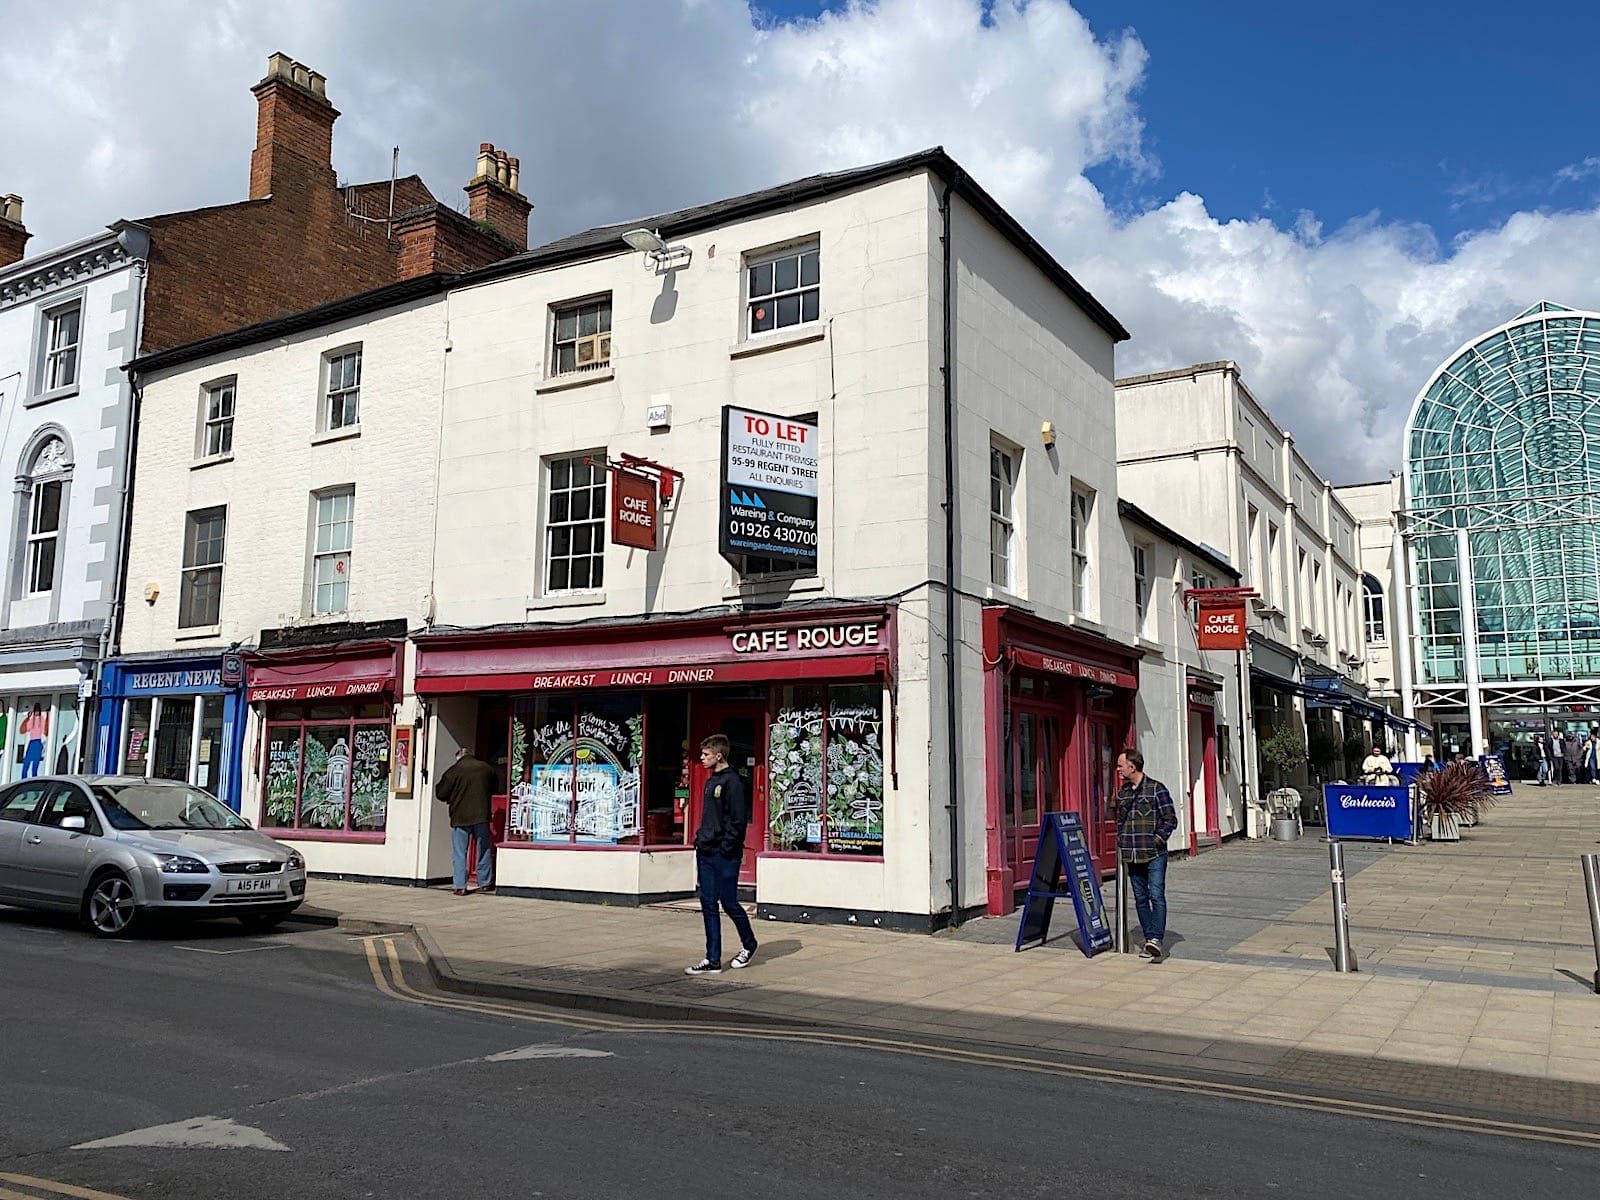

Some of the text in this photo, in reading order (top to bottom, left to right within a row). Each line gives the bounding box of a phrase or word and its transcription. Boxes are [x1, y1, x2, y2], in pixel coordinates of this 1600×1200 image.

[744, 415, 808, 443] TO LET
[752, 438, 801, 454] FULLY FITTED
[732, 444, 817, 467] RESTAURANT PREMISES
[732, 456, 818, 479] 95-99 REGENT STREET
[749, 472, 803, 488] ALL ENQUIRIES
[619, 509, 652, 527] ROUGE
[731, 505, 816, 529] Wareing & Company
[730, 520, 817, 545] 01926 430700
[730, 538, 816, 557] wareingandcompany.co.uk
[797, 624, 879, 649] ROUGE
[1204, 625, 1239, 634] ROUGE
[1042, 657, 1072, 675] BREAKFAST
[133, 669, 221, 688] REGENT NEWS
[533, 669, 714, 688] BREAKFAST LUNCH DINNER
[252, 682, 380, 701] BREAKFAST LUNCH DINNER
[555, 720, 571, 734] the
[271, 740, 283, 751] LYT
[1340, 794, 1396, 809] Carluccio's
[840, 831, 883, 840] INSTALLATION
[237, 879, 271, 890] A15 FAH
